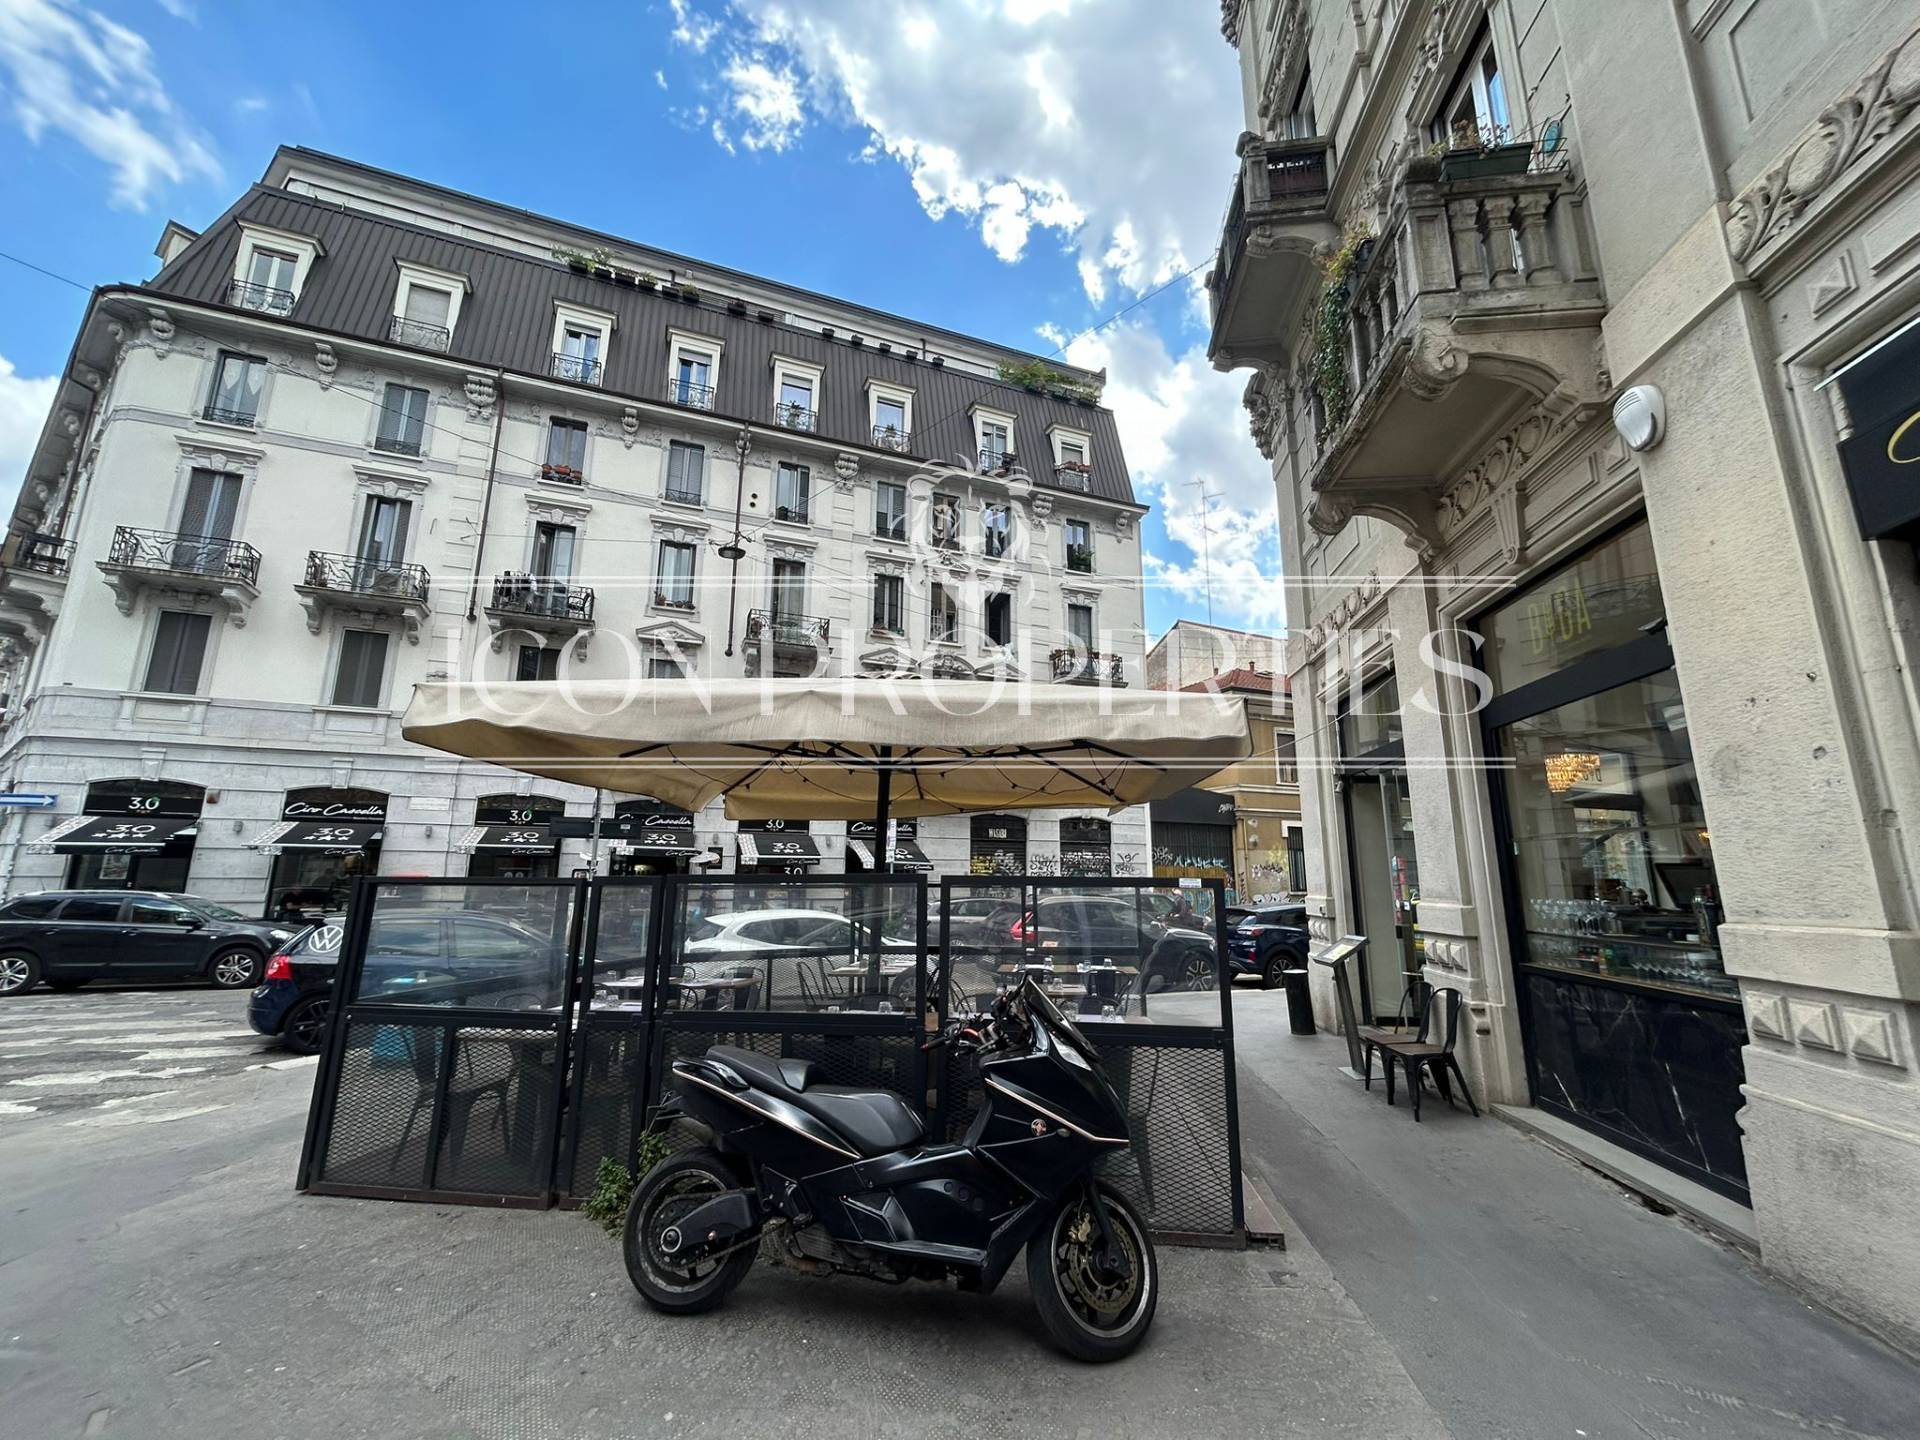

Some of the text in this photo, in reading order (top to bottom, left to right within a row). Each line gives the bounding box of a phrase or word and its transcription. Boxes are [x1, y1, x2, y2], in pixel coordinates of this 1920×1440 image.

[128, 797, 160, 810] 3.0
[285, 802, 322, 815] Ciro
[509, 810, 532, 821] 3.0
[106, 824, 156, 834] 3.0
[312, 827, 354, 836] 3.0
[506, 831, 539, 839] 3.0
